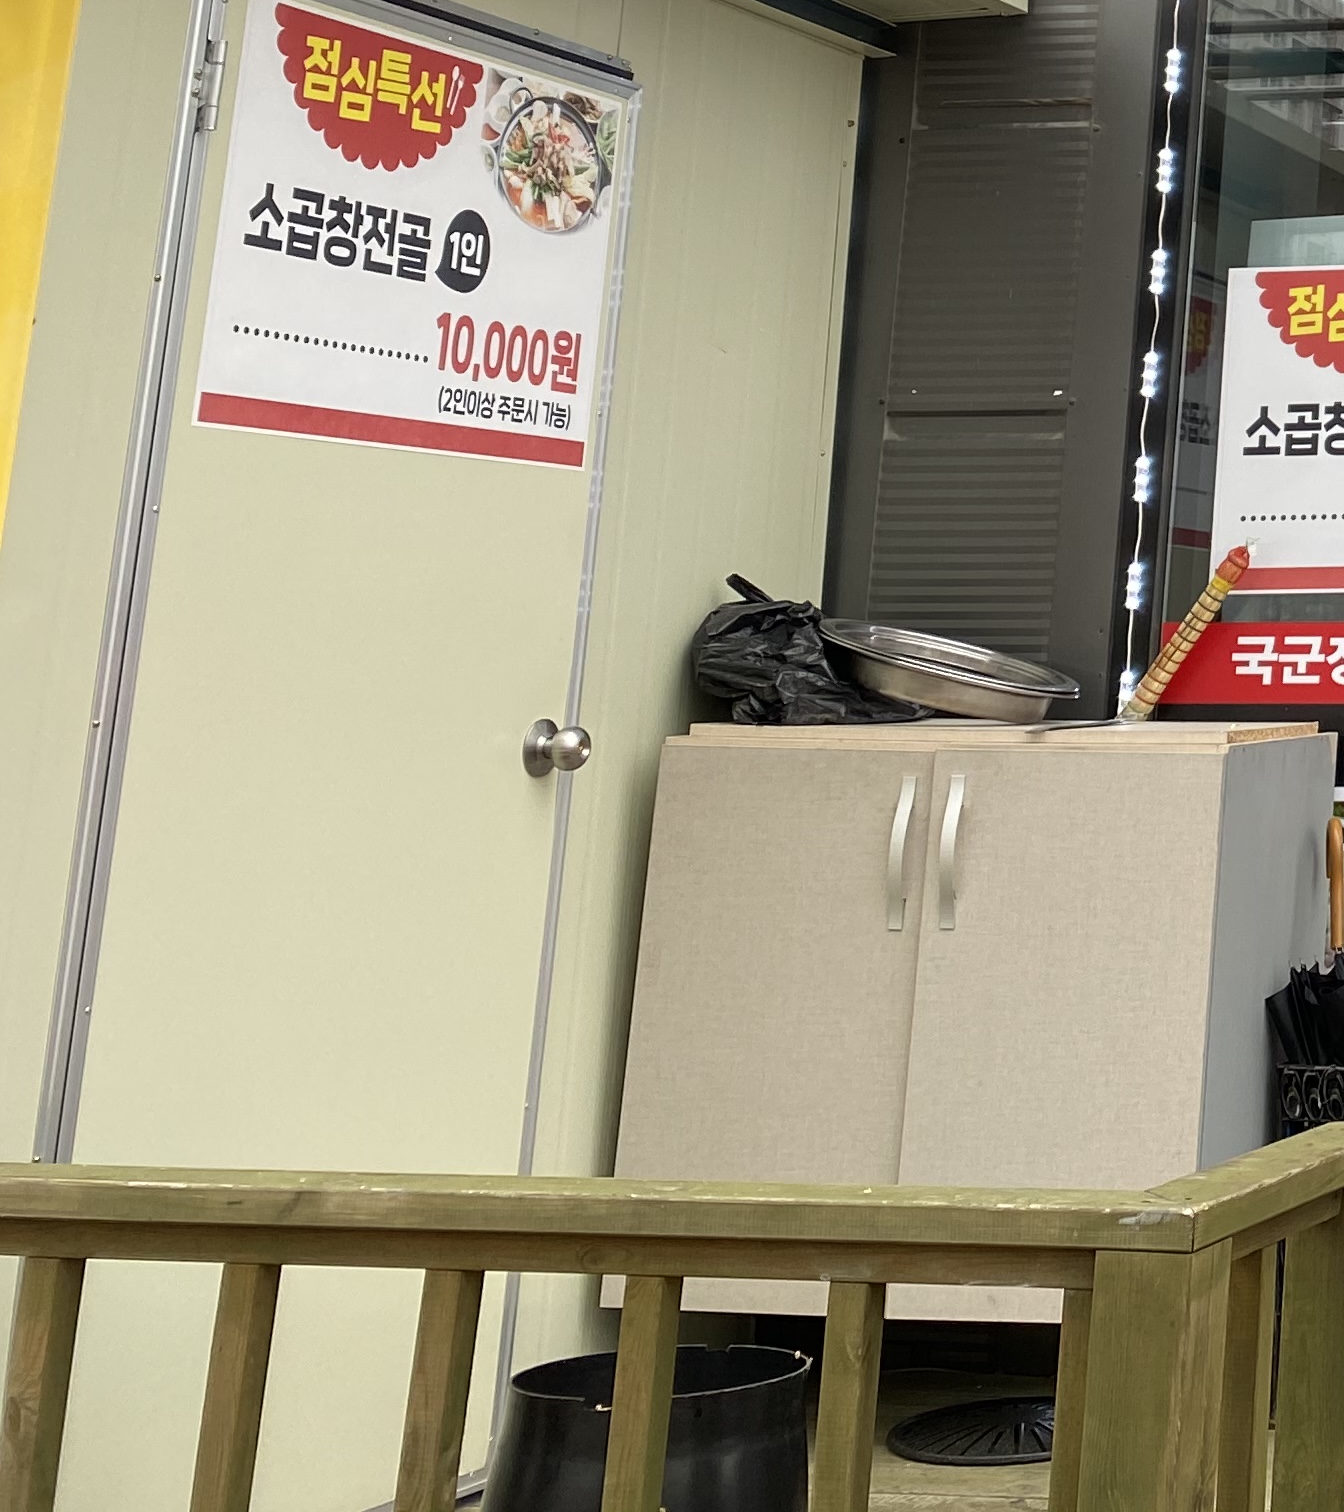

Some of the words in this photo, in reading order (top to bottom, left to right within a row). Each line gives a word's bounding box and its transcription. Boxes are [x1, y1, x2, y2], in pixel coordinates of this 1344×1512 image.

[302, 34, 448, 134] 점심특선
[242, 182, 433, 282] 소곱창전골
[447, 229, 485, 277] 1인
[435, 311, 582, 395] 10,000원
[438, 385, 496, 419] (2인이상
[497, 395, 539, 425] 주문시
[541, 401, 571, 430] 가능)
